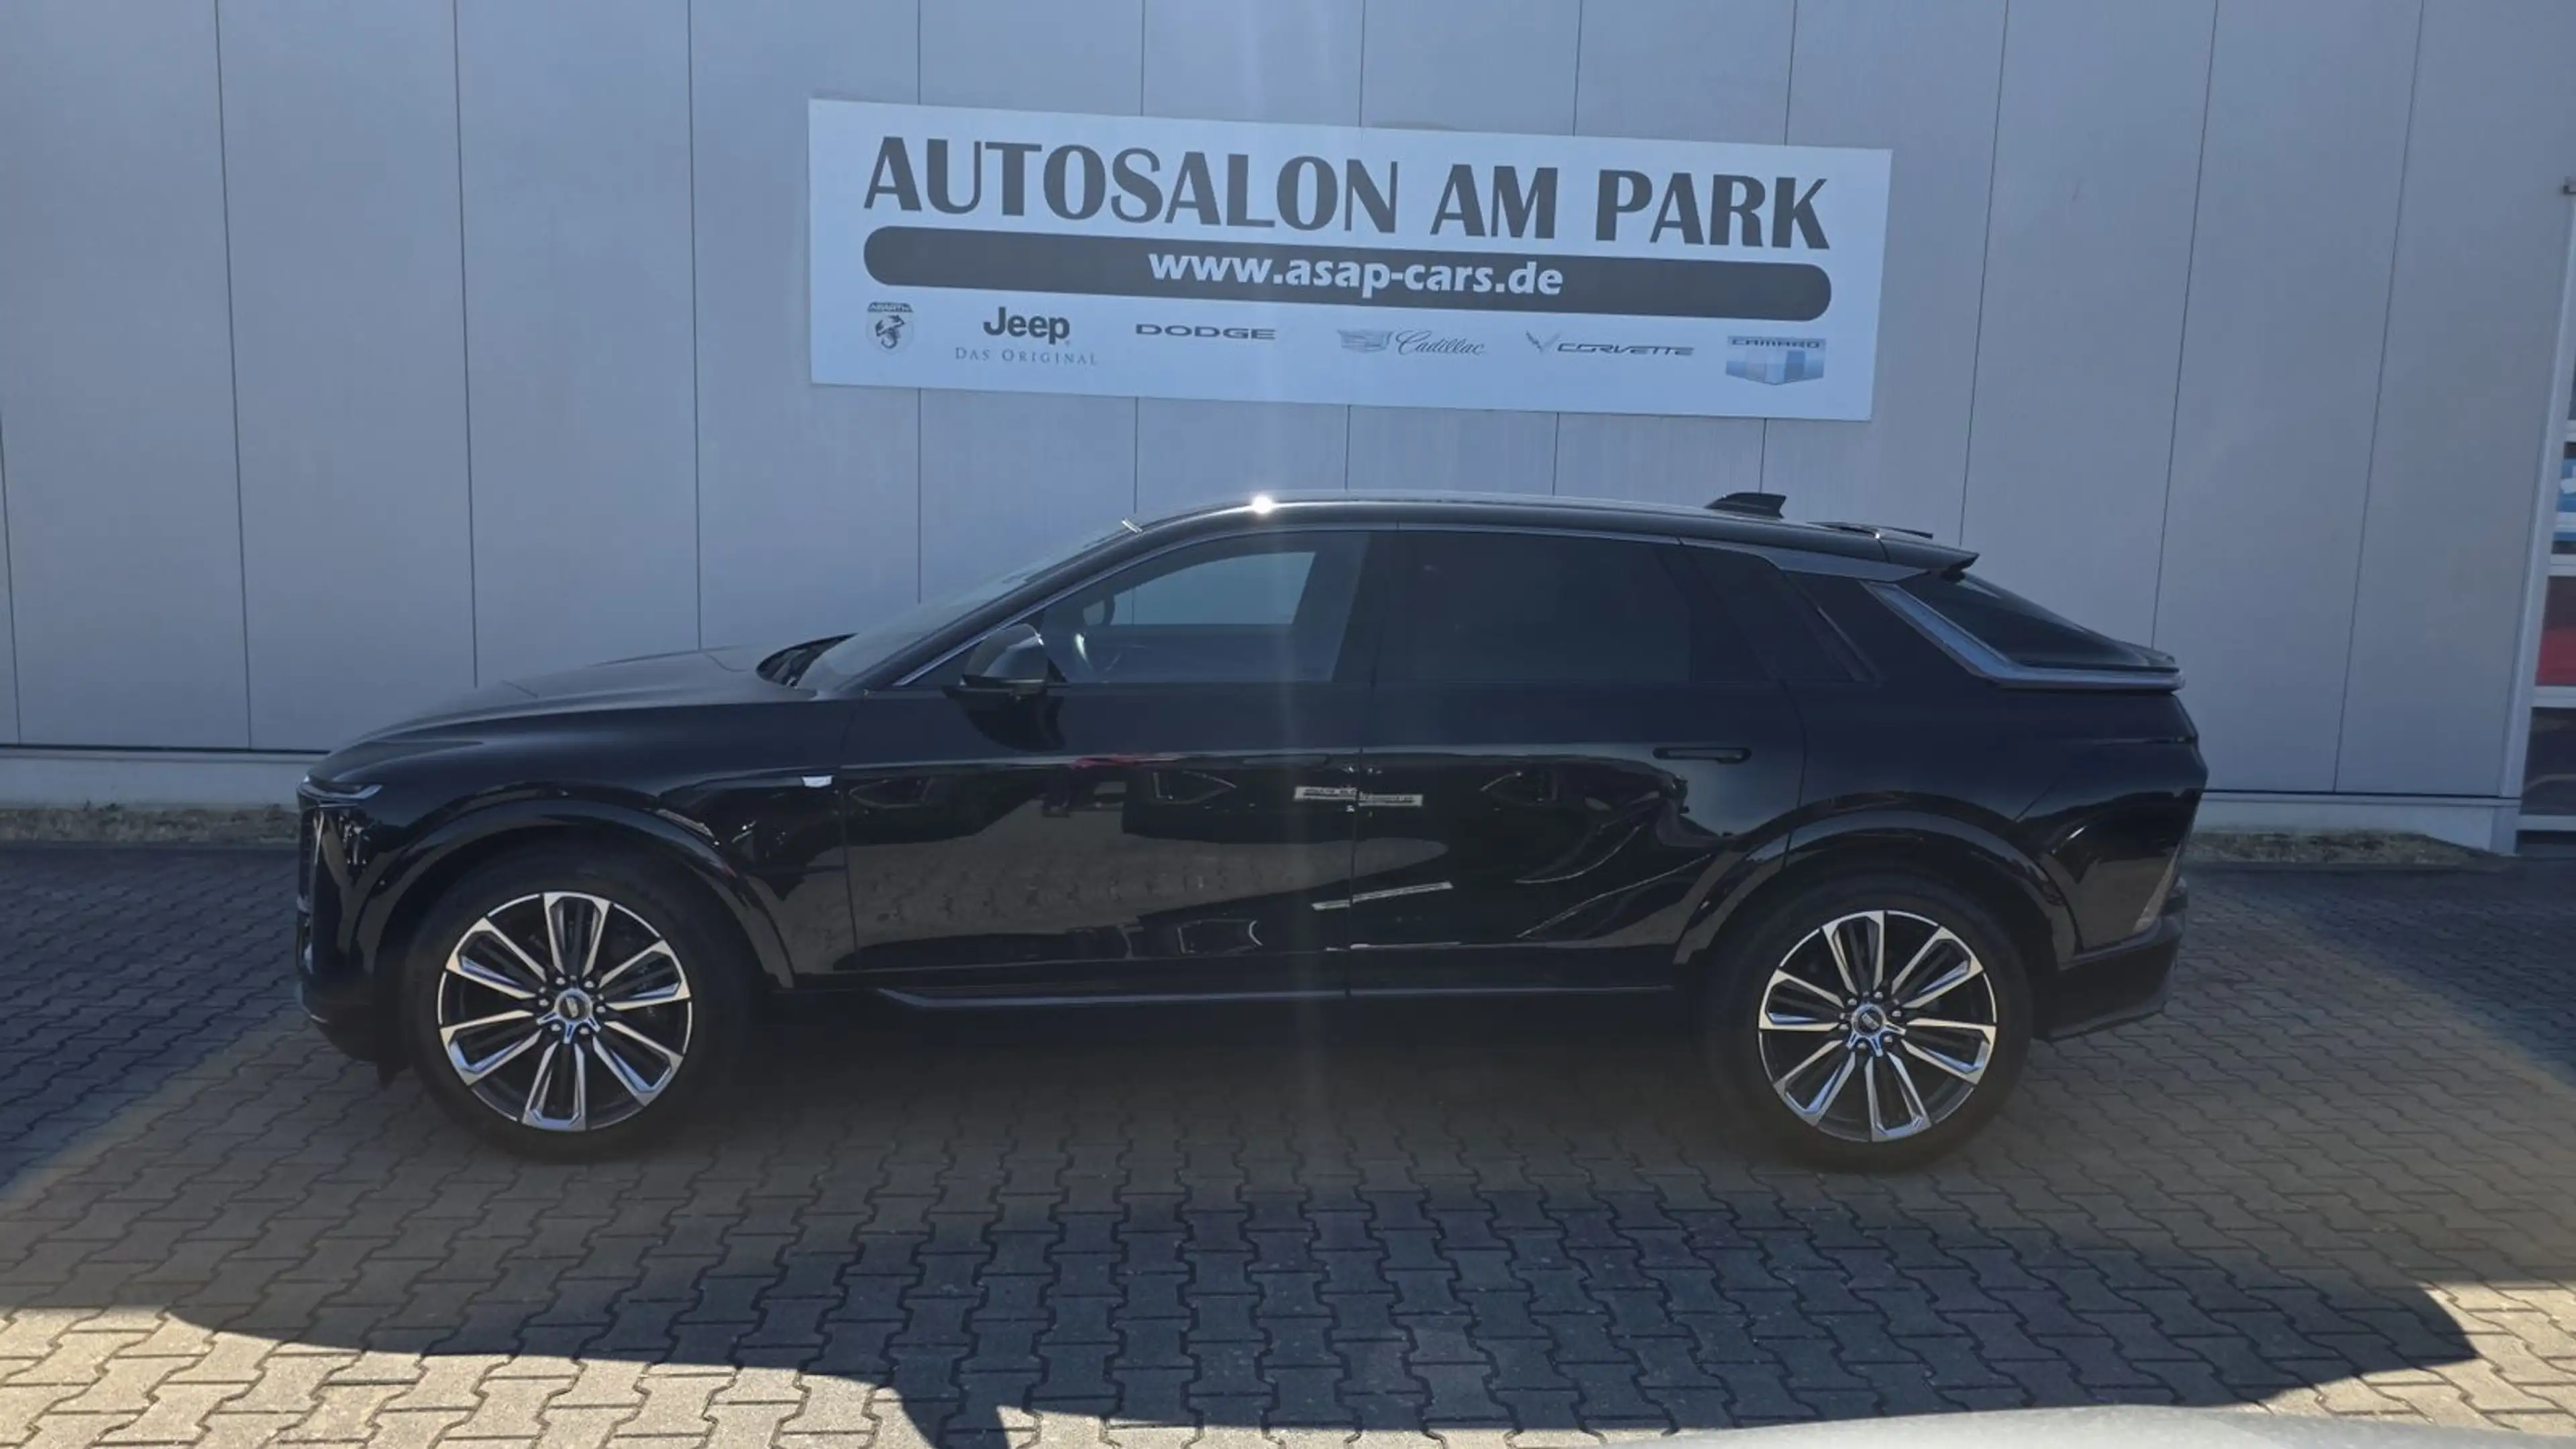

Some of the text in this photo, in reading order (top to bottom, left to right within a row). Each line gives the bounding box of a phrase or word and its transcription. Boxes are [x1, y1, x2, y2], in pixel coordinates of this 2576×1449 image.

[863, 136, 1831, 250] AUTOSALON AM PARK
[1148, 254, 1563, 298] www.asap-cars.de
[983, 306, 1070, 345] Jeep
[1136, 323, 1276, 340] DODGE
[1395, 329, 1485, 356] Cadillac
[1557, 342, 1695, 357] CORVETTE
[955, 347, 1099, 366] DAS ORIGINAL
